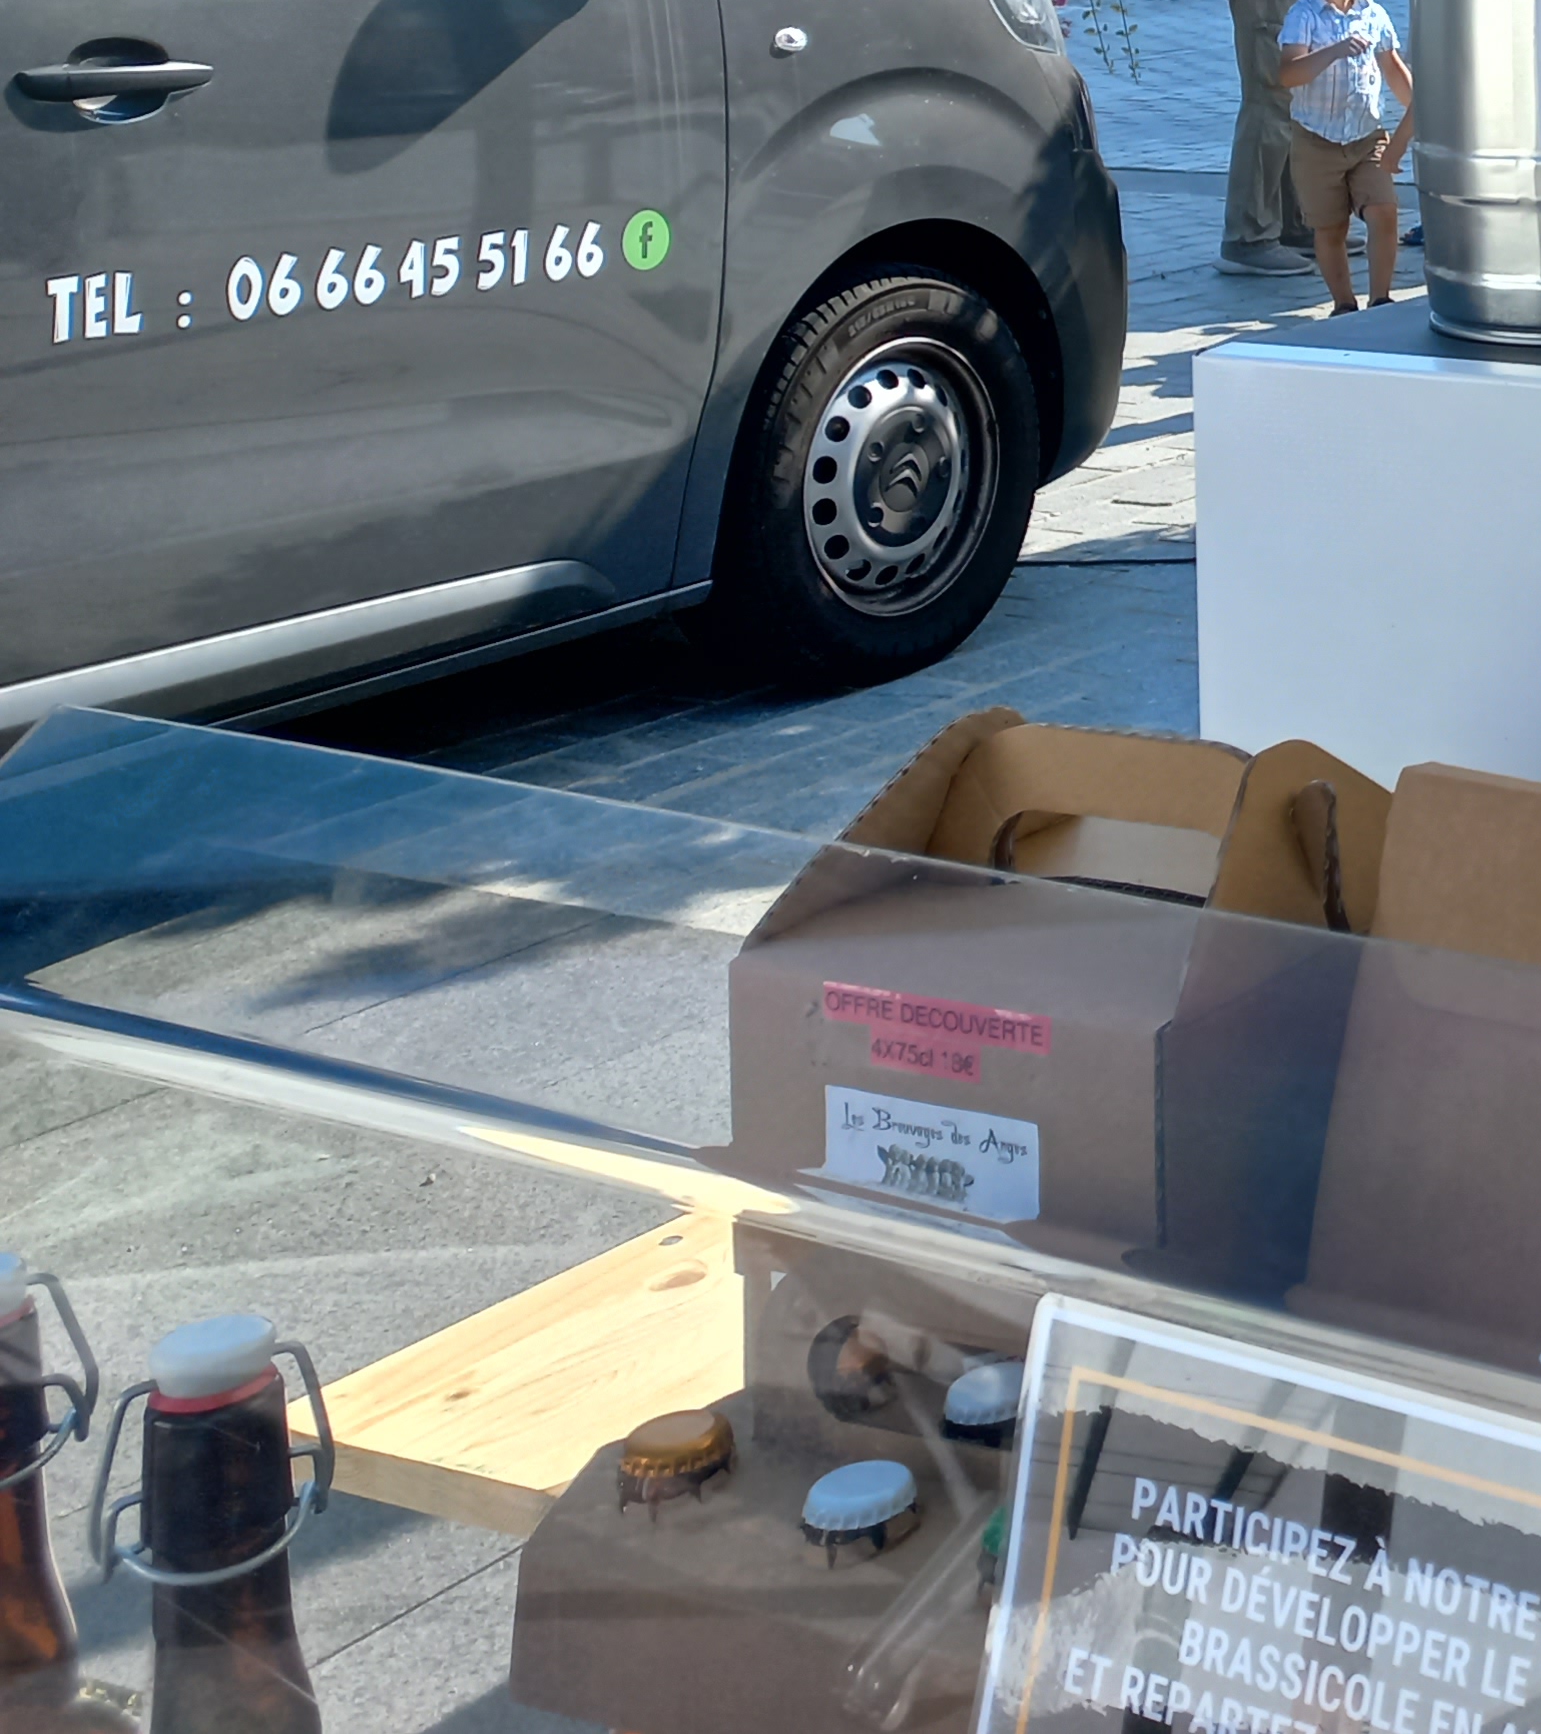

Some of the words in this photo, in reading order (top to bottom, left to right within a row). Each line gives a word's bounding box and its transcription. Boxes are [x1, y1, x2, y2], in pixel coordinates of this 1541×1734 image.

[46, 272, 143, 344] TEL
[226, 255, 302, 321] 06
[315, 244, 387, 311] 66
[398, 235, 462, 299] 45
[476, 228, 531, 291] 51
[543, 221, 605, 283] 66
[825, 991, 894, 1021] OFFRE
[901, 1002, 1044, 1046] DECOUVERTE
[872, 1106, 944, 1148] Breuvages
[979, 1128, 1028, 1164] Anges
[1131, 1476, 1357, 1585] PARTICIPEZ
[1363, 1536, 1392, 1597] À
[1404, 1558, 1541, 1641] NOTRE
[1062, 1647, 1114, 1702] ET
[1111, 1533, 1213, 1605] POUR
[1221, 1566, 1471, 1688] DÉVELOPPER
[1481, 1649, 1532, 1707] LE
[1178, 1618, 1421, 1732] BRASSICOLE
